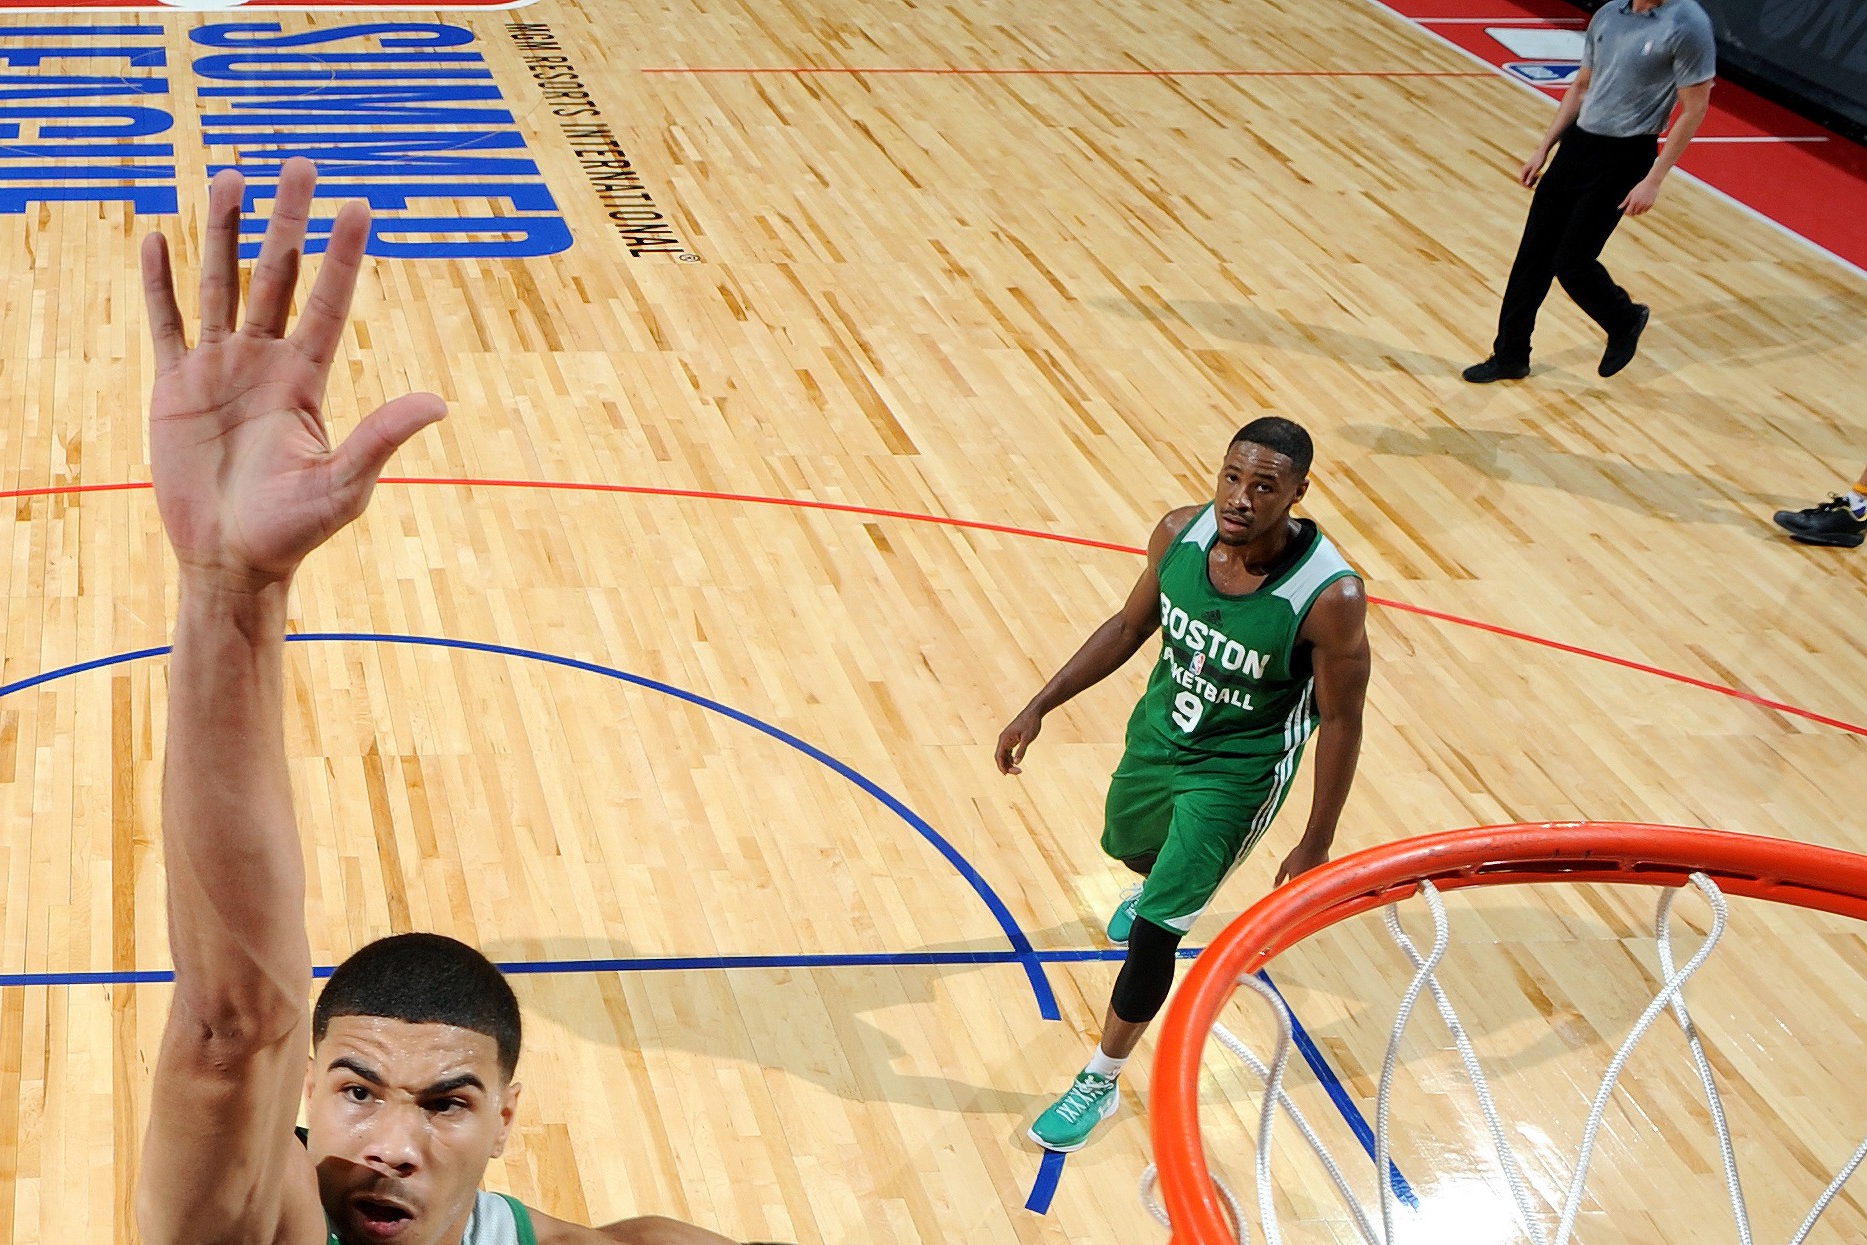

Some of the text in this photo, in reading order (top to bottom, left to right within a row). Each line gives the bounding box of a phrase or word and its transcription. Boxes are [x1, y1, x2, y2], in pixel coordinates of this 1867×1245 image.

[188, 22, 574, 260] SUMMER
[505, 23, 685, 258] MGM RESORTS INTERNATIONAL
[1172, 690, 1204, 733] 9
